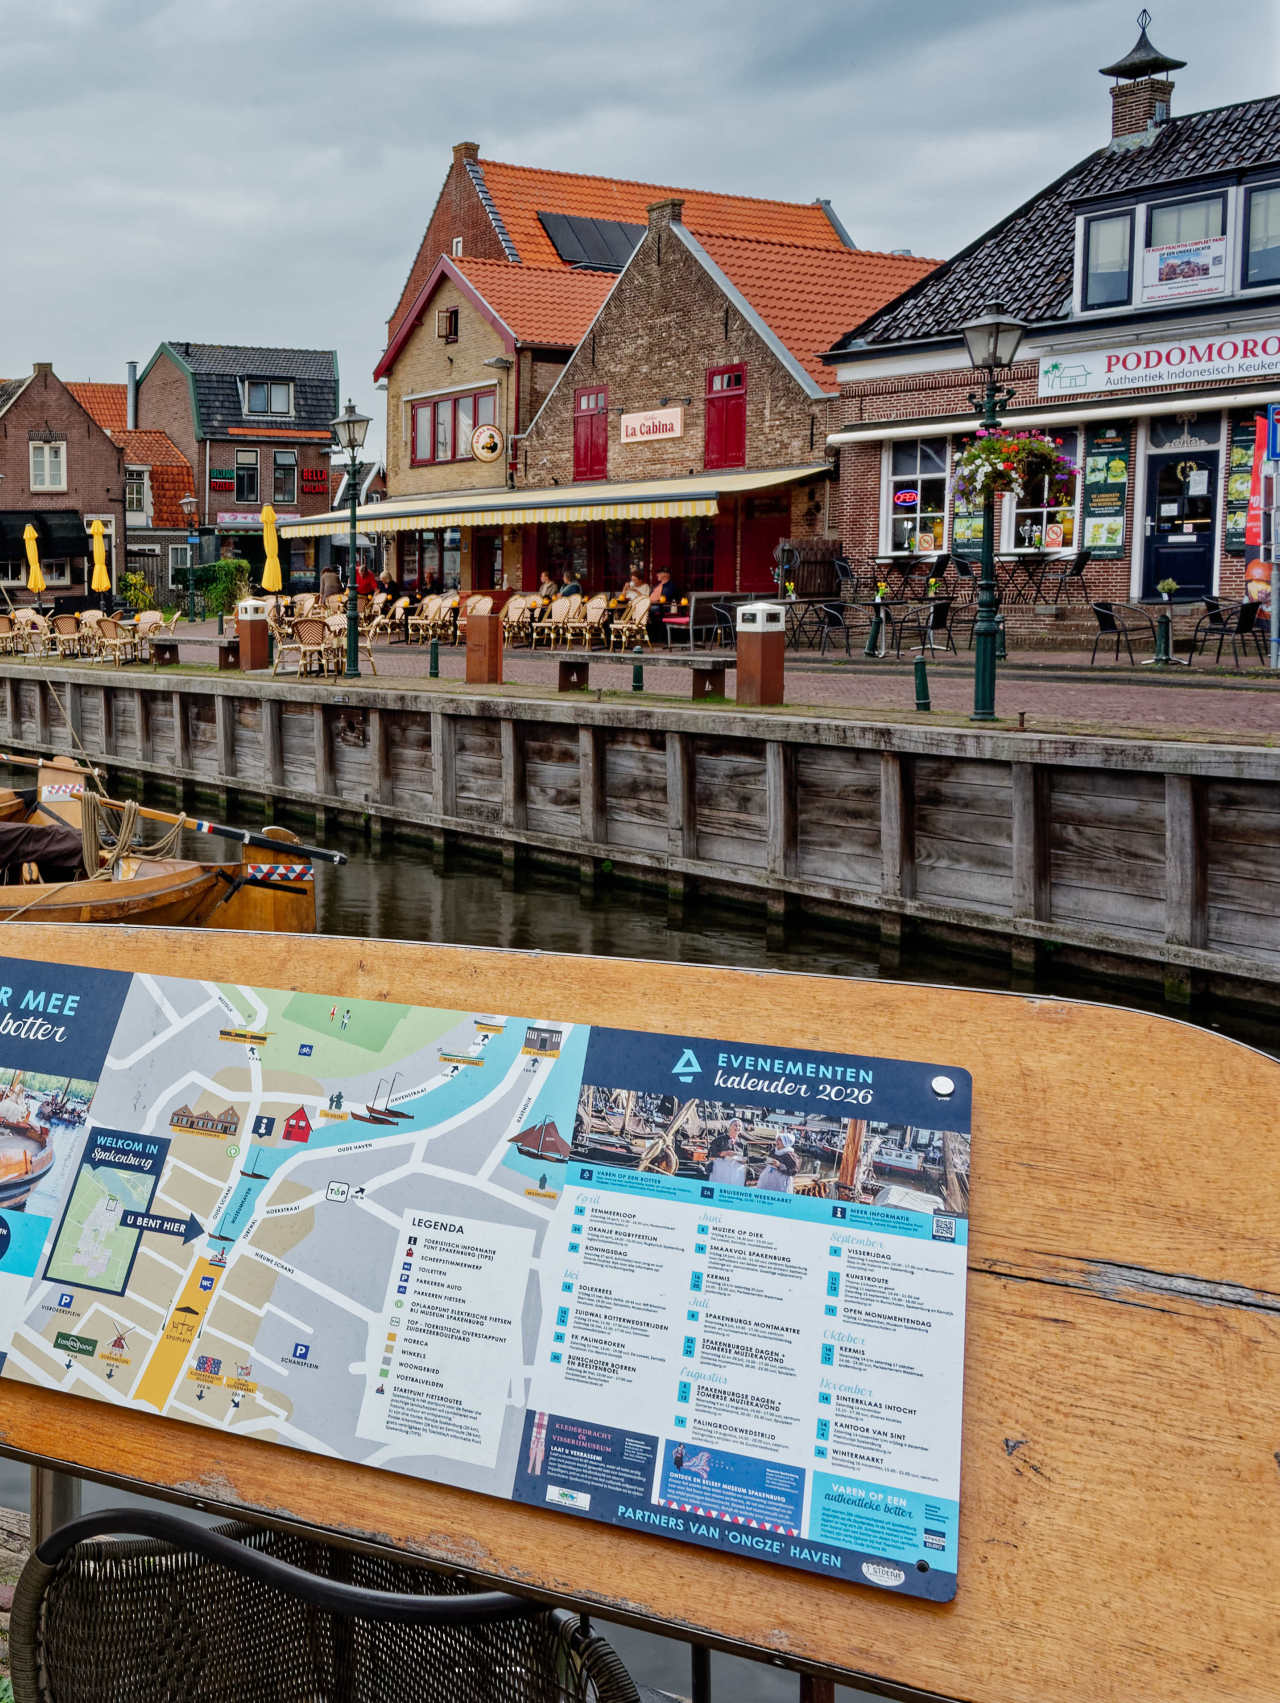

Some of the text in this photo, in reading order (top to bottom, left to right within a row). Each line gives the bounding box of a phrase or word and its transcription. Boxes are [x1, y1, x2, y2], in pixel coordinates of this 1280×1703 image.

[1104, 336, 1280, 373] PODOMORO
[1105, 373, 1164, 386] Authentiek
[1167, 363, 1235, 380] Indonesisch
[625, 420, 674, 438] La Cabina
[303, 468, 328, 480] BELLA
[895, 492, 918, 504] OPEN
[20, 989, 81, 1016] MEE
[717, 1052, 873, 1084] EVENEMENTEN
[714, 1069, 874, 1105] kalender 2026
[96, 1135, 158, 1155] WELKOM IN
[91, 1147, 153, 1171] Spakenburg
[126, 1215, 186, 1234] U BENT HIER
[412, 1217, 465, 1235] LEGENDA
[588, 1226, 613, 1235] ORANJE
[424, 1238, 496, 1255] TOERISTISCH INFORMATIE
[440, 1247, 476, 1258] SPAKENBURG
[585, 1245, 628, 1256] KONINGSDAG
[710, 1245, 792, 1263] SMAAKVOL SPAKENBURG
[847, 1248, 892, 1260] VISSERIJDAG
[419, 1267, 447, 1276] TOILETTEN
[846, 1273, 889, 1285] KUNSTROUTE
[416, 1278, 462, 1291] PARKEREN AUTO
[413, 1290, 466, 1304] PARKEREN FIETSEN
[411, 1301, 512, 1325] OPLAADPUNT ELEKTRISCHE FIETSEN
[420, 1309, 445, 1319] MUSEUM
[446, 1314, 485, 1326] SPAKENBURG
[843, 1307, 932, 1328] OPEN MONUMENTENDAG
[424, 1322, 461, 1334] TOERISTISCH
[462, 1327, 507, 1343] OVERSTAPPUNT
[705, 1312, 801, 1335] SPAKENBURGS MONTMARTRE
[403, 1337, 428, 1347] HORECA
[580, 1336, 626, 1349] PALINGROKEN
[702, 1338, 753, 1353] SPAKENBURGSE
[755, 1348, 780, 1358] DAGEN
[839, 1346, 865, 1356] KERMIS
[401, 1349, 426, 1359] WINKELS
[568, 1354, 609, 1367] BUNSCHOTER
[702, 1344, 784, 1364] ZOMERSE MUZIEKAVOND
[281, 1357, 319, 1370] SCHANSPLEIN
[399, 1361, 440, 1375] WOONGEBIED
[393, 1386, 424, 1398] STARTPUNT
[697, 1385, 749, 1400] SPAKENBURGSE
[750, 1395, 776, 1405] DAGEN
[696, 1391, 780, 1412] ZOMERSE MUZIEKAVOND
[836, 1394, 917, 1416] SINTERKLAAS INTOCHT
[834, 1422, 906, 1441] KANTOOR VAN SINT
[832, 1448, 884, 1464] WINTERMARKT
[832, 1482, 907, 1507] VAREN OP EEN
[618, 1505, 684, 1532] PARTNERS
[689, 1521, 720, 1540] VAN
[790, 1545, 842, 1569] HAVEN
